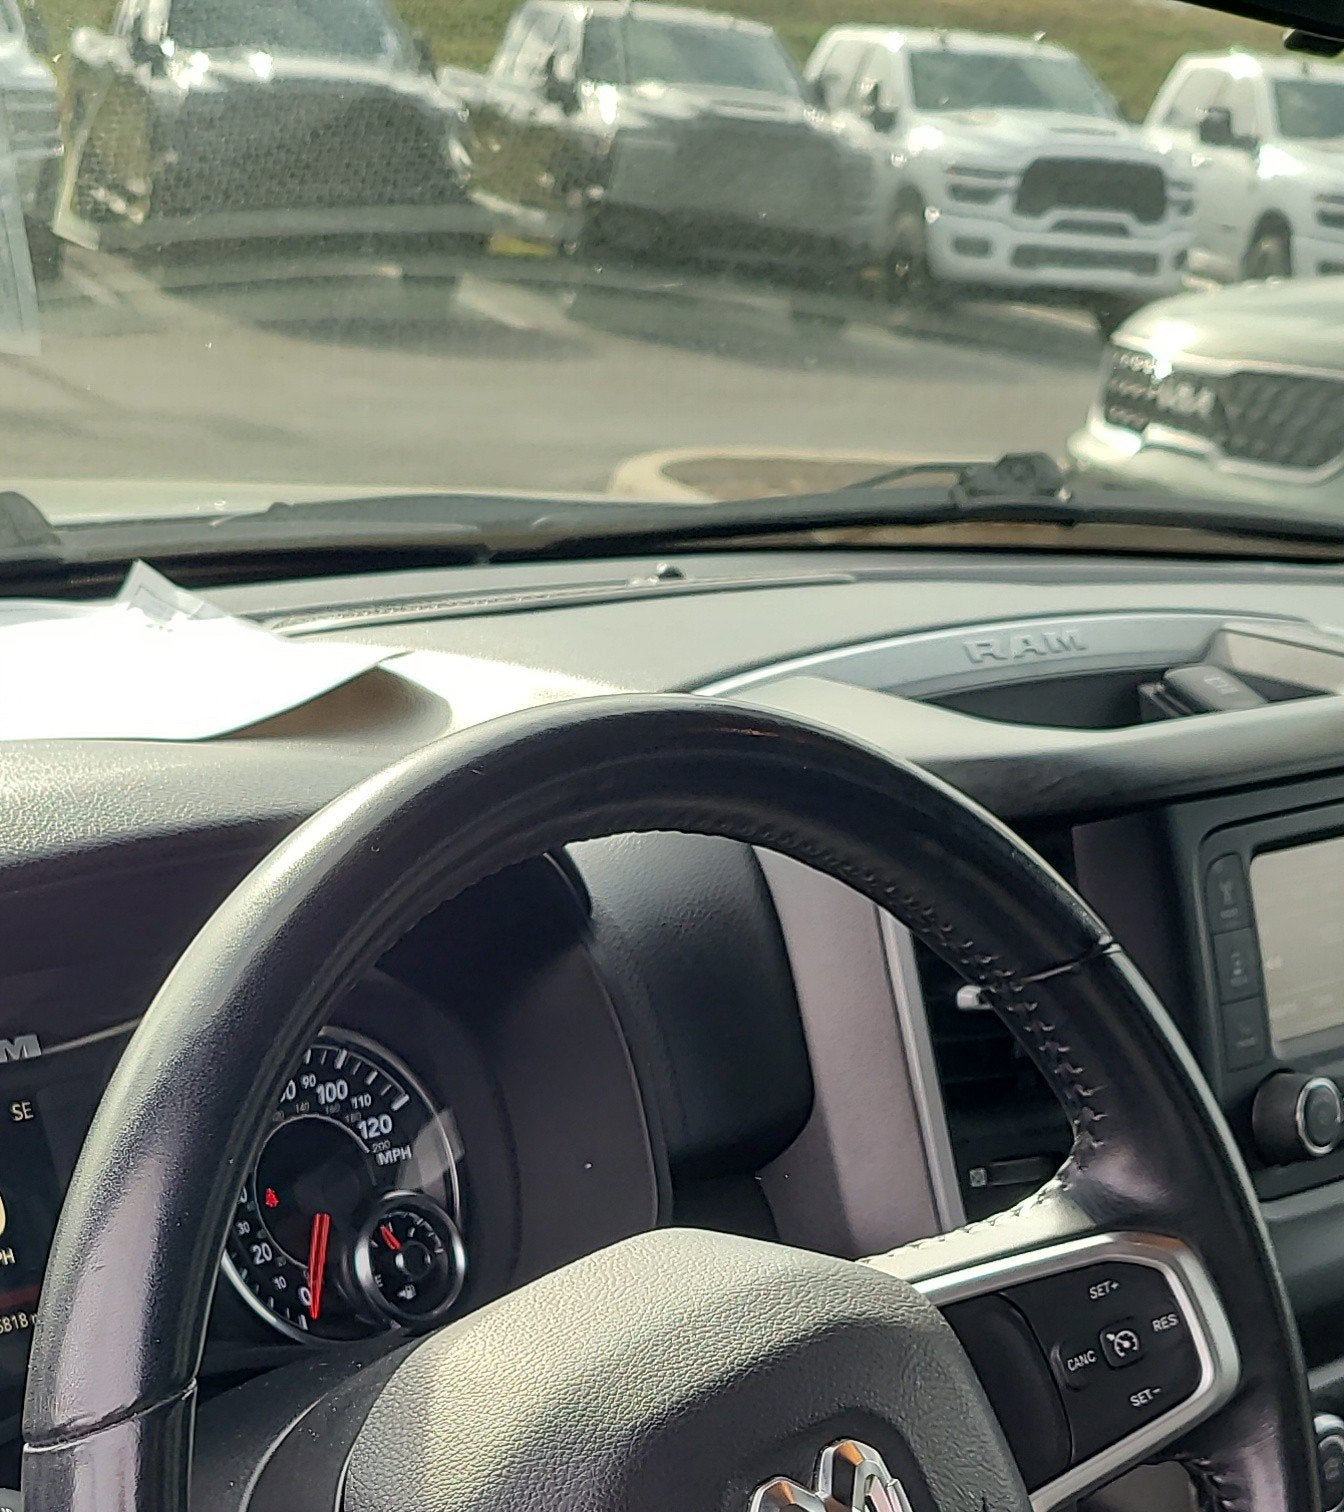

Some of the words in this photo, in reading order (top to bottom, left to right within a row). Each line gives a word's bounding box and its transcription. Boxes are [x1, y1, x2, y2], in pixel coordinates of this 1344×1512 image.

[962, 628, 1089, 664] RAM
[280, 1080, 296, 1102] 0
[301, 1074, 316, 1089] 90
[316, 1079, 348, 1105] 100
[10, 1101, 34, 1122] SE
[351, 1094, 372, 1109] 110
[358, 1114, 393, 1139] 120
[376, 1146, 412, 1166] MPH
[252, 1242, 273, 1266] 20
[1089, 1280, 1120, 1300] SET+
[1151, 1313, 1180, 1332] RES
[1067, 1350, 1098, 1373] CANC
